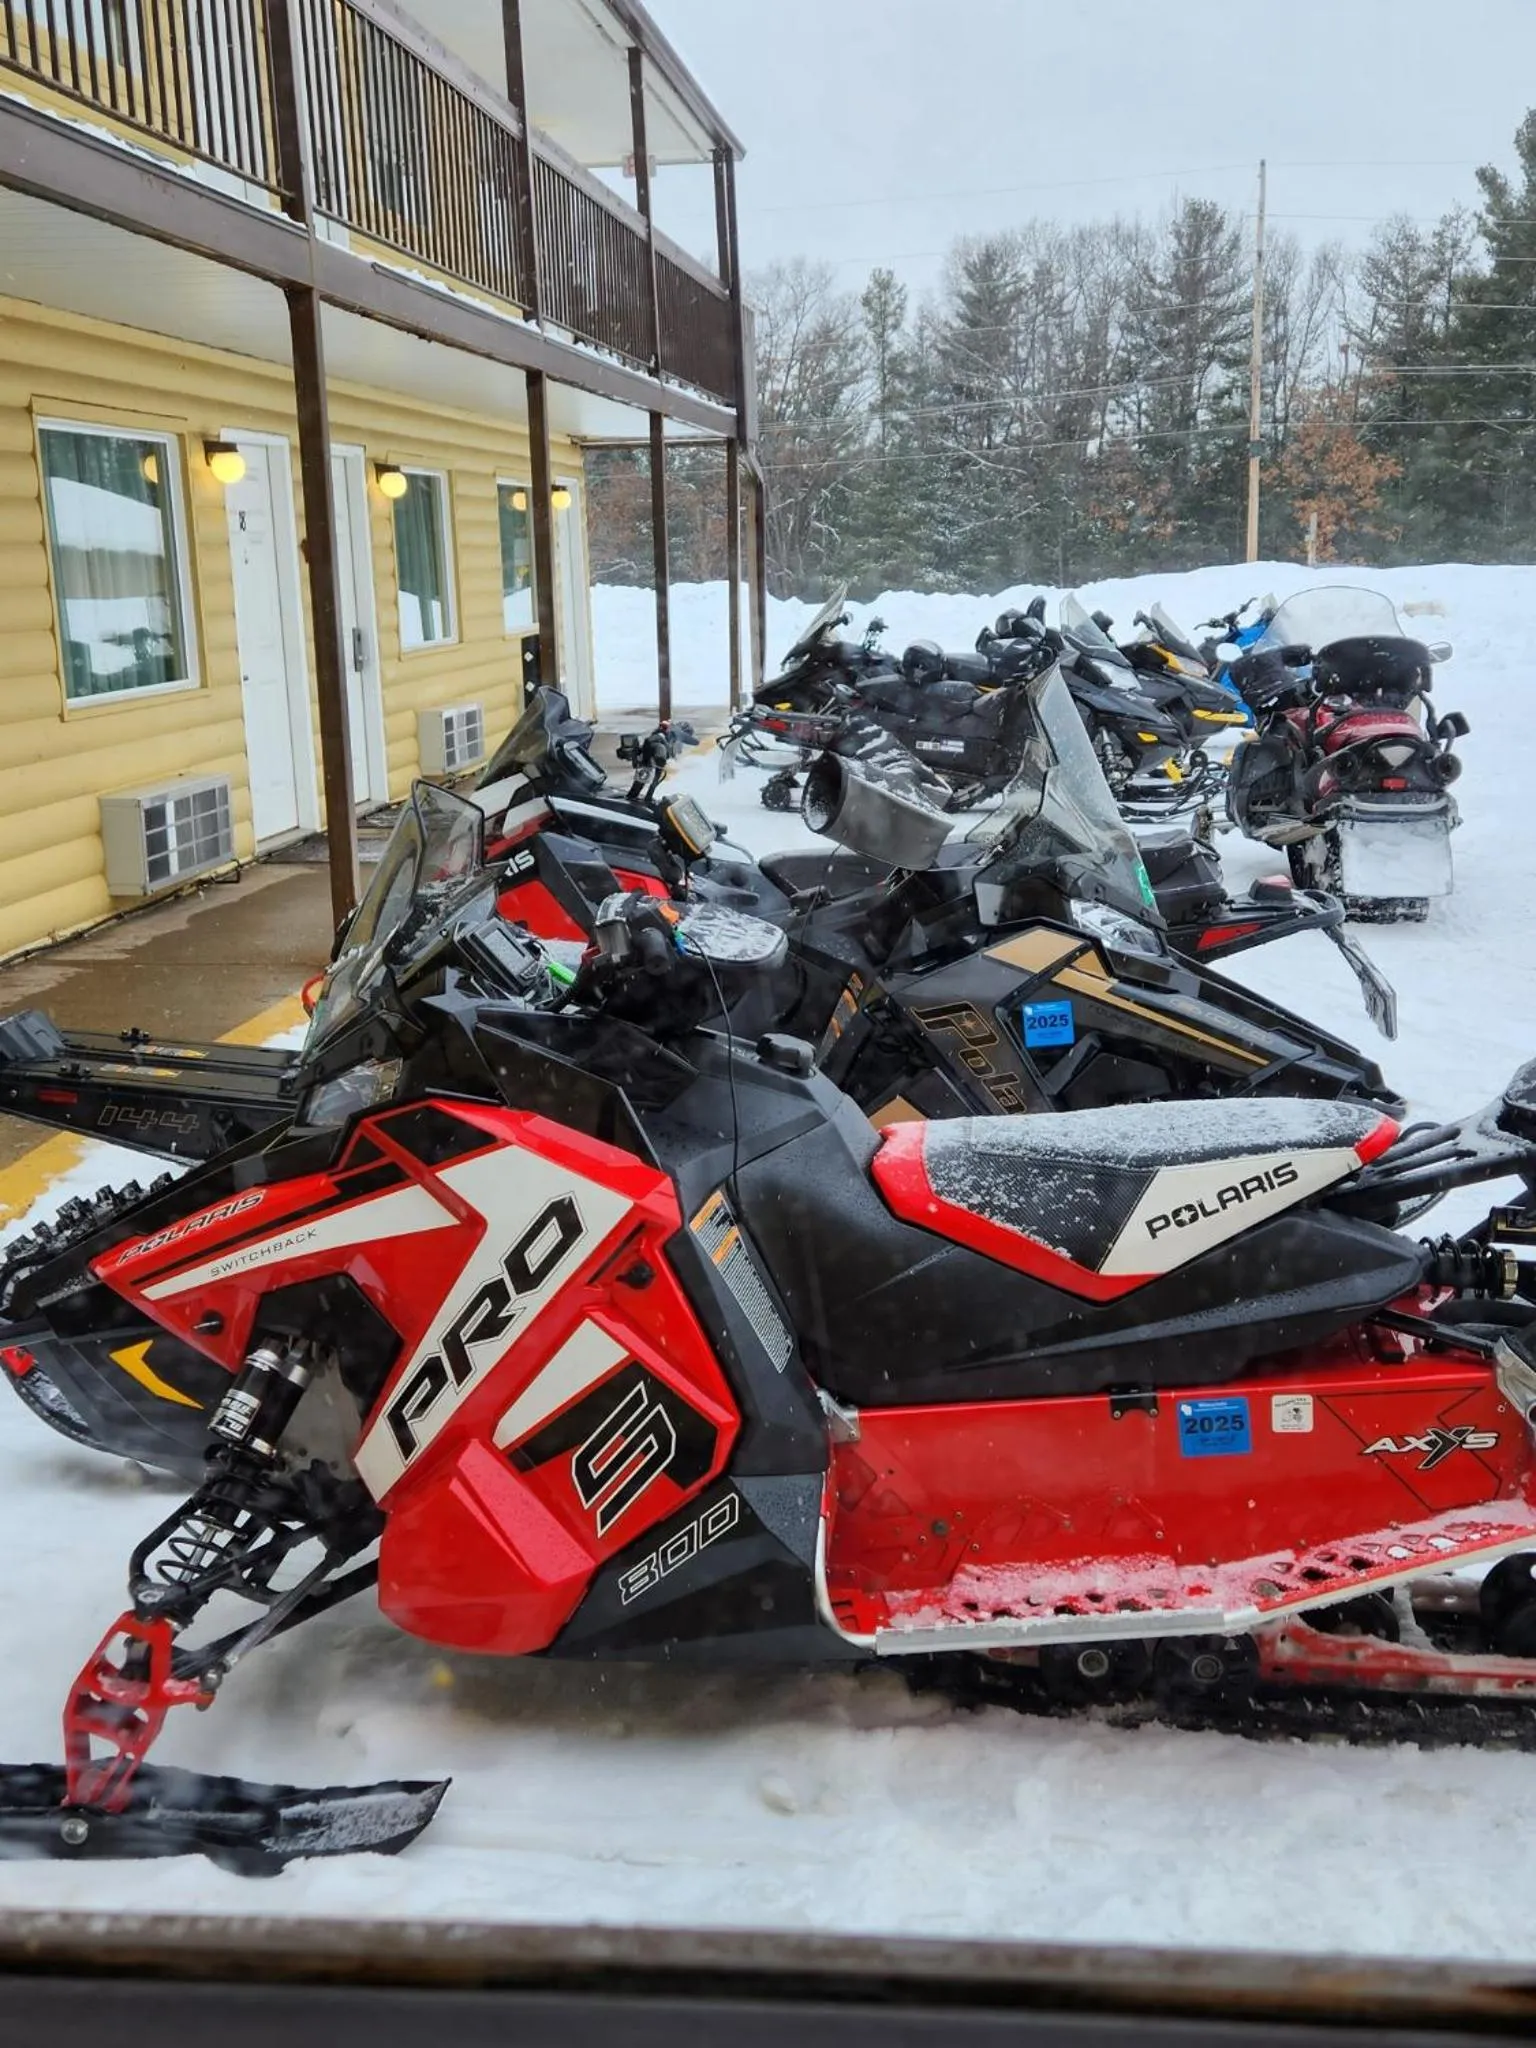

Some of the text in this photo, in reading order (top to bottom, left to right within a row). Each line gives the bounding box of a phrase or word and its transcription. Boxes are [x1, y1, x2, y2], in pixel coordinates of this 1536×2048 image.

[504, 849, 535, 876] IS
[1026, 1013, 1070, 1031] 2025
[97, 1105, 200, 1134] 144
[1145, 1161, 1299, 1240] POLARIS
[116, 1189, 267, 1267] POLARIS
[209, 1227, 318, 1278] SWITCHBACK
[386, 1191, 589, 1467] PRO
[1184, 1414, 1245, 1435] 2025
[1362, 1426, 1499, 1470] AXYS
[618, 1492, 740, 1606] 800
